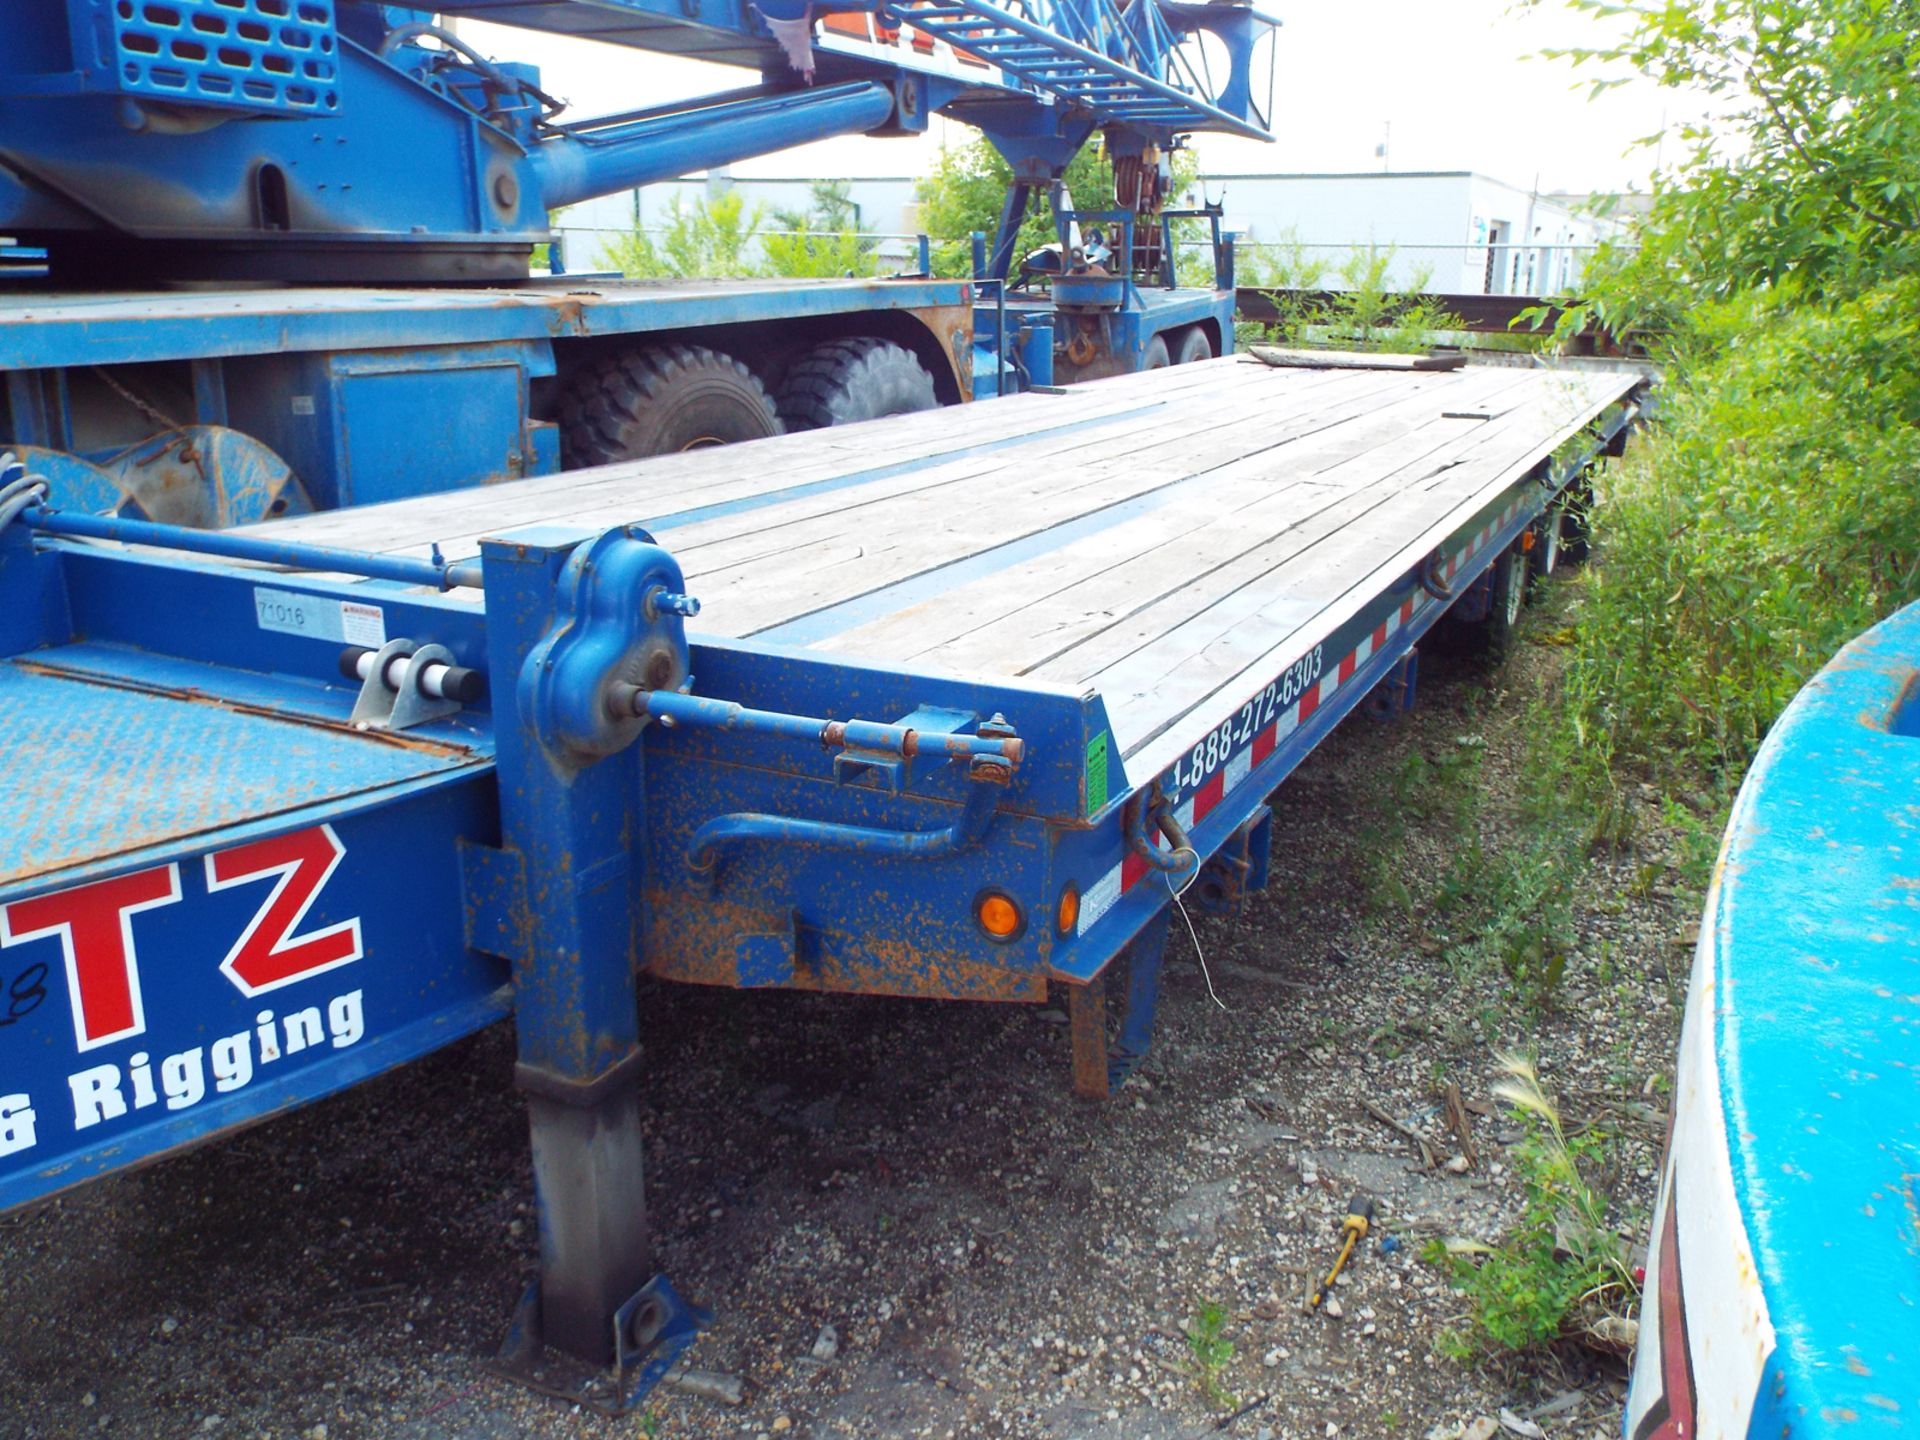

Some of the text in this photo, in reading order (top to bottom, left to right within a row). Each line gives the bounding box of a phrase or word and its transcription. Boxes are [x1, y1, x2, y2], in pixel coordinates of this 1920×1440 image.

[259, 601, 305, 625] 71016
[1173, 643, 1323, 805] 1-888-272-6303
[67, 988, 365, 1131] Rigging
